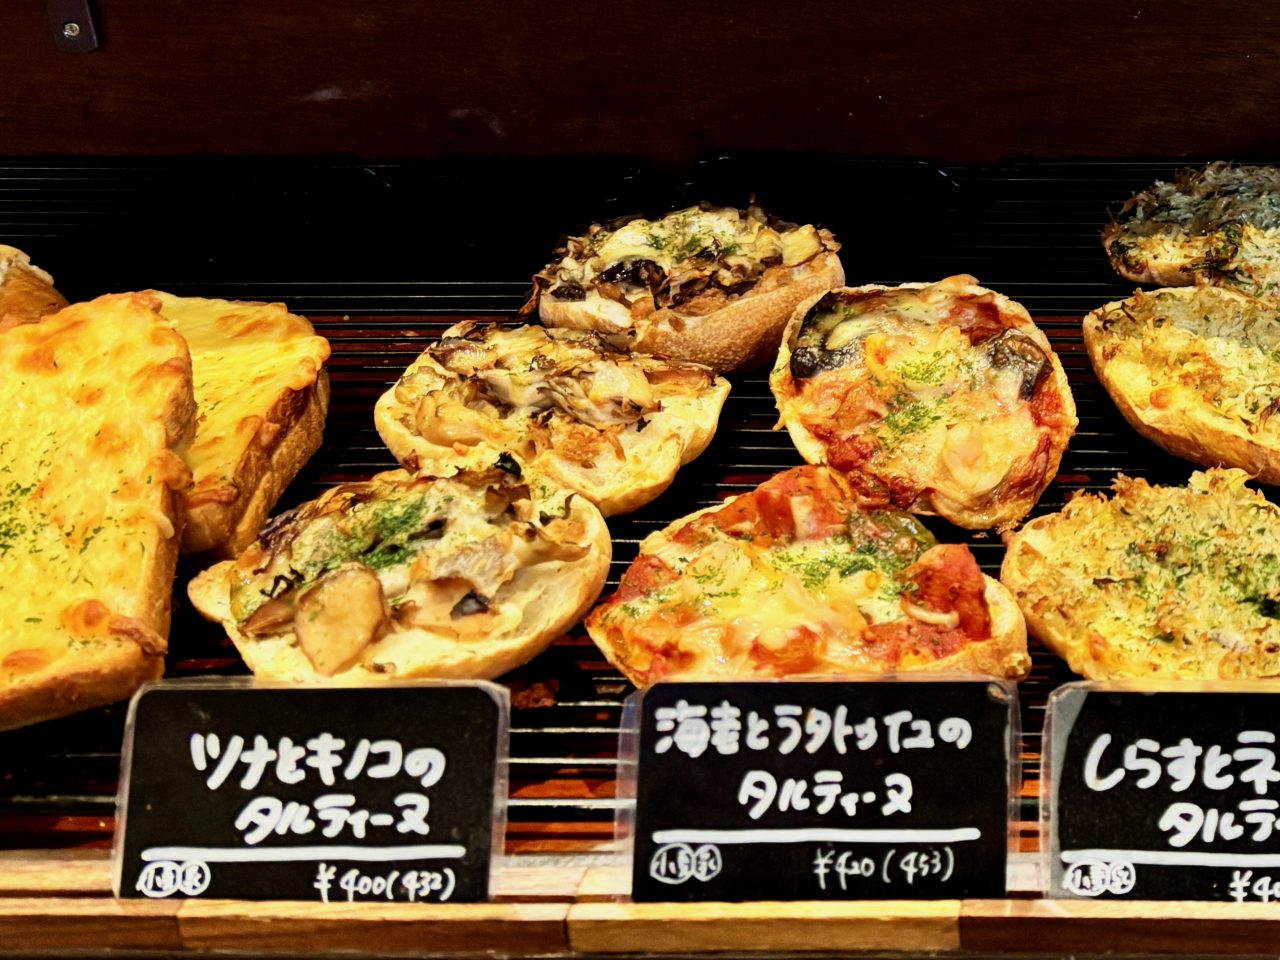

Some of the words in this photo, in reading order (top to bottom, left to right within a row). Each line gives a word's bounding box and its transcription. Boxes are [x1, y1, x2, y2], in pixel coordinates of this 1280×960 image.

[190, 732, 446, 790] ツナとキノコの
[235, 793, 430, 844] タルティーヌ
[738, 770, 913, 819] タルティーヌ
